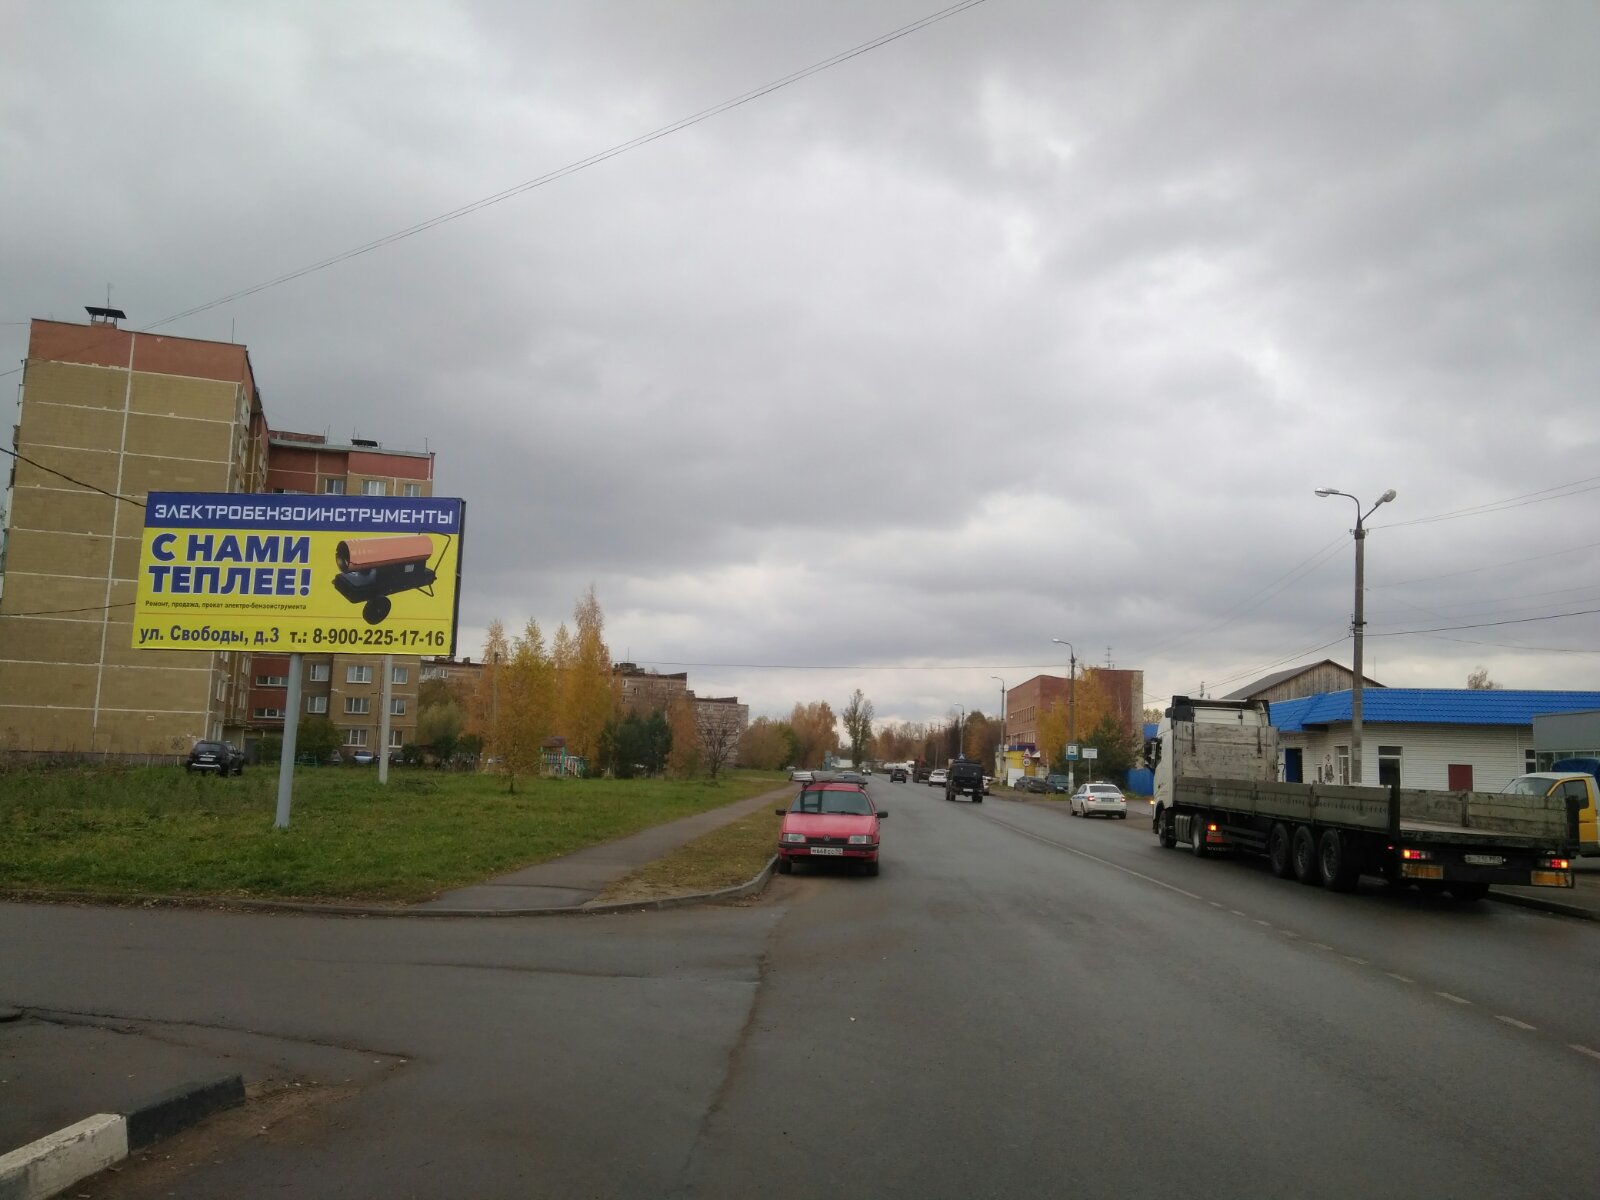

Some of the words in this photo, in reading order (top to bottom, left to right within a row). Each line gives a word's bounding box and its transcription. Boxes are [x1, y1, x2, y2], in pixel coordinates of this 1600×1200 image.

[155, 504, 453, 525] ЭЛЕКТРОБЕНЗОИНСТРУМЕНТЫ
[151, 532, 178, 562] С
[186, 534, 311, 564] НАМИ
[148, 565, 312, 597] ТЕПЛЕЕ!
[145, 600, 170, 608] Ремонт,
[202, 602, 223, 610] прокат
[138, 627, 164, 644] ул.
[170, 625, 249, 645] Свободы,
[253, 627, 280, 645] д.3
[289, 631, 308, 644] т.:
[312, 627, 445, 647] 8-900-225-17-16
